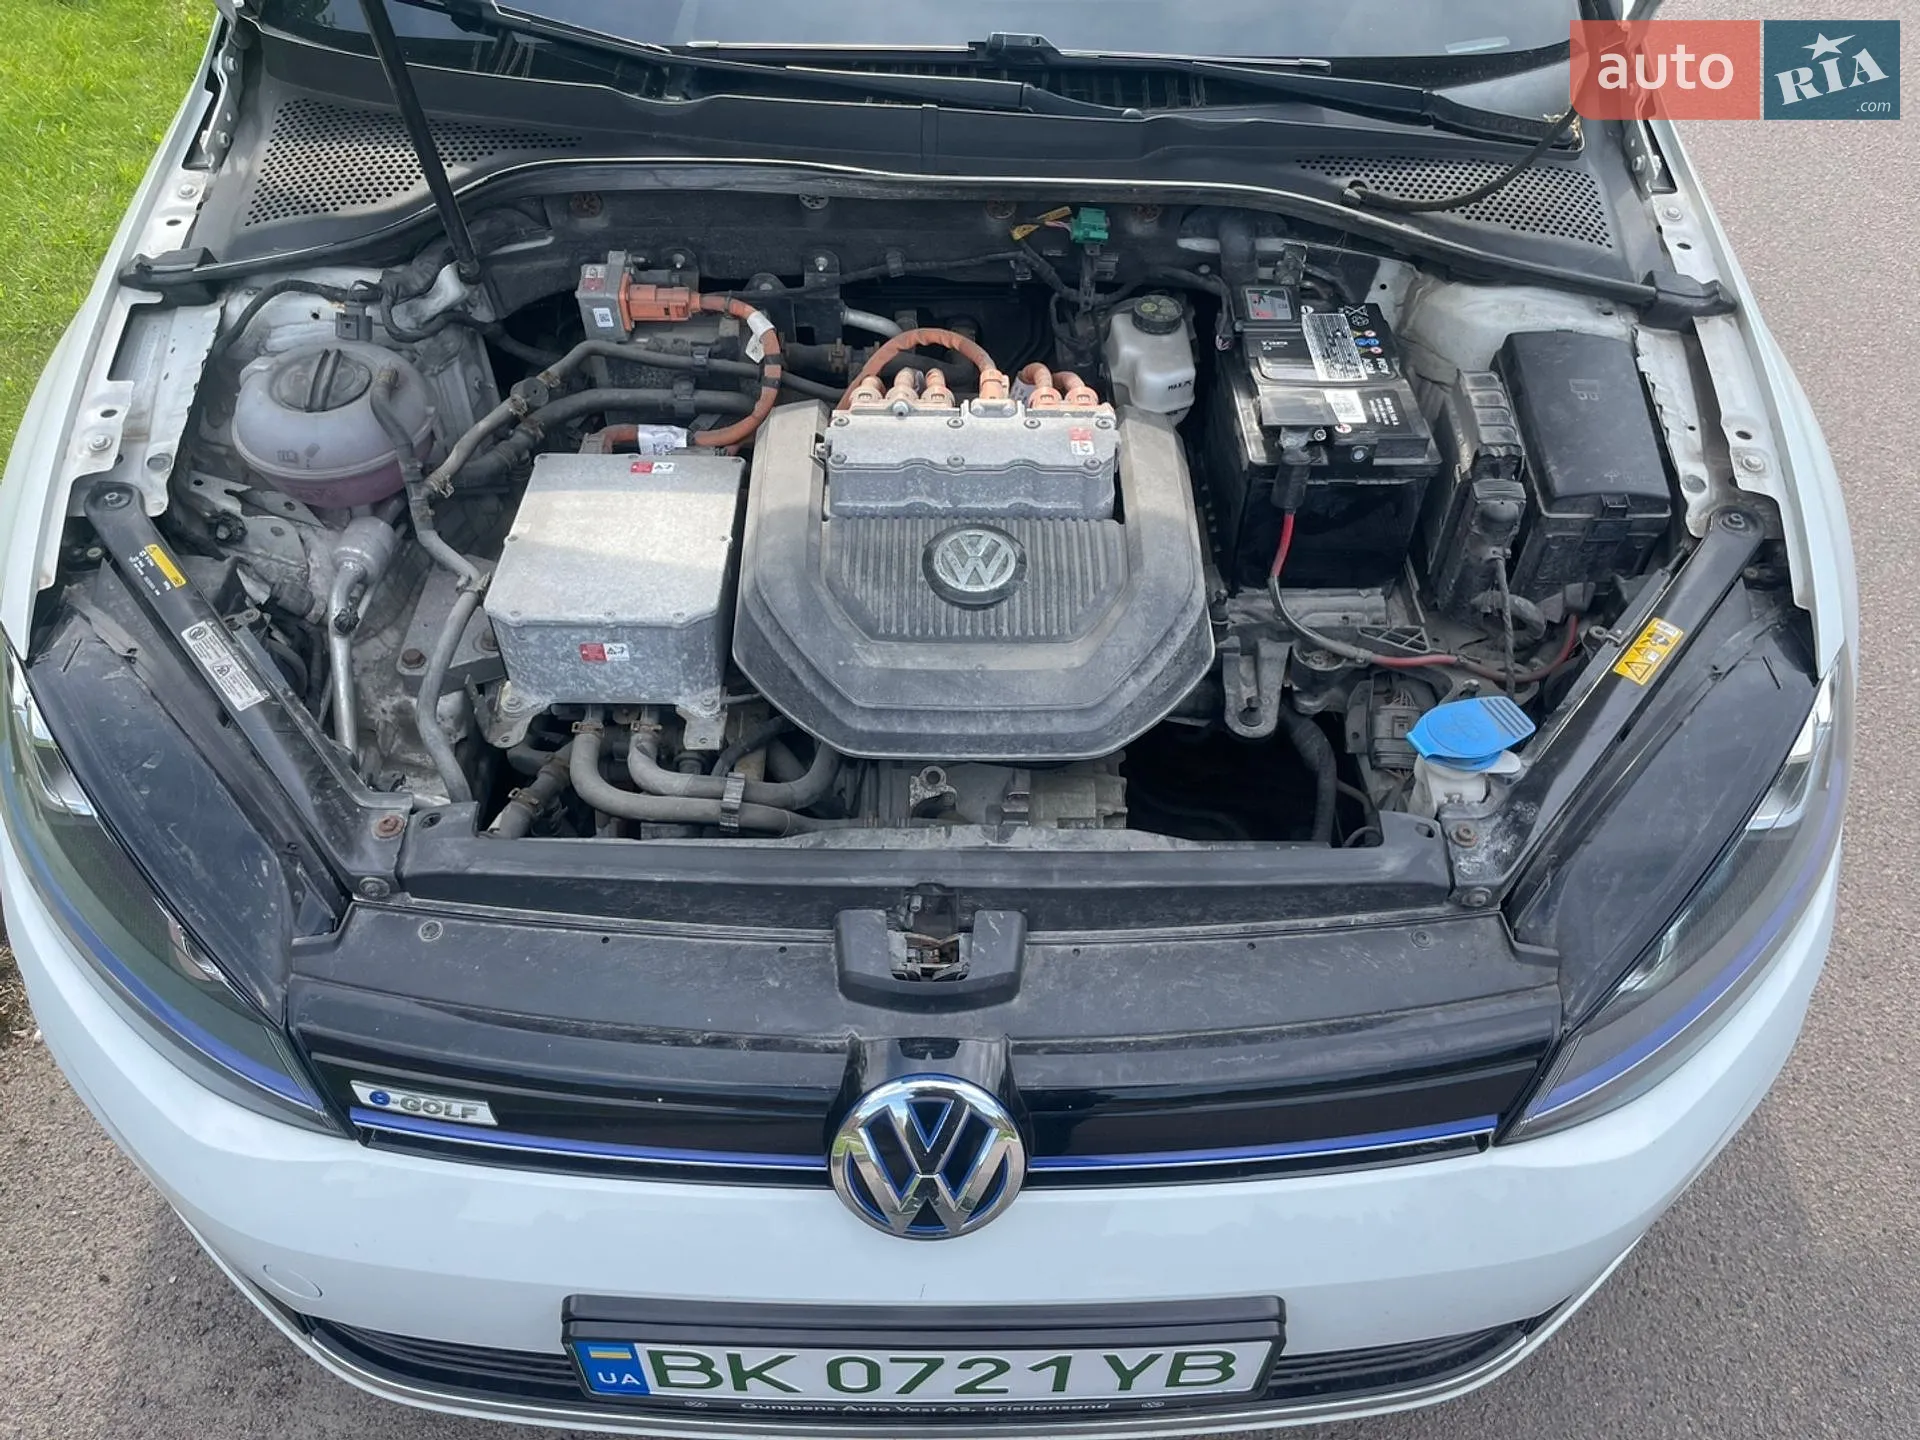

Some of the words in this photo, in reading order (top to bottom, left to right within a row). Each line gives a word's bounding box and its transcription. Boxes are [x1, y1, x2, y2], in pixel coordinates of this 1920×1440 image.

[598, 1372, 640, 1385] UA
[647, 1350, 802, 1393] BK
[826, 1355, 1073, 1394] 0721
[1103, 1351, 1236, 1391] YB
[843, 1404, 890, 1412] Auto
